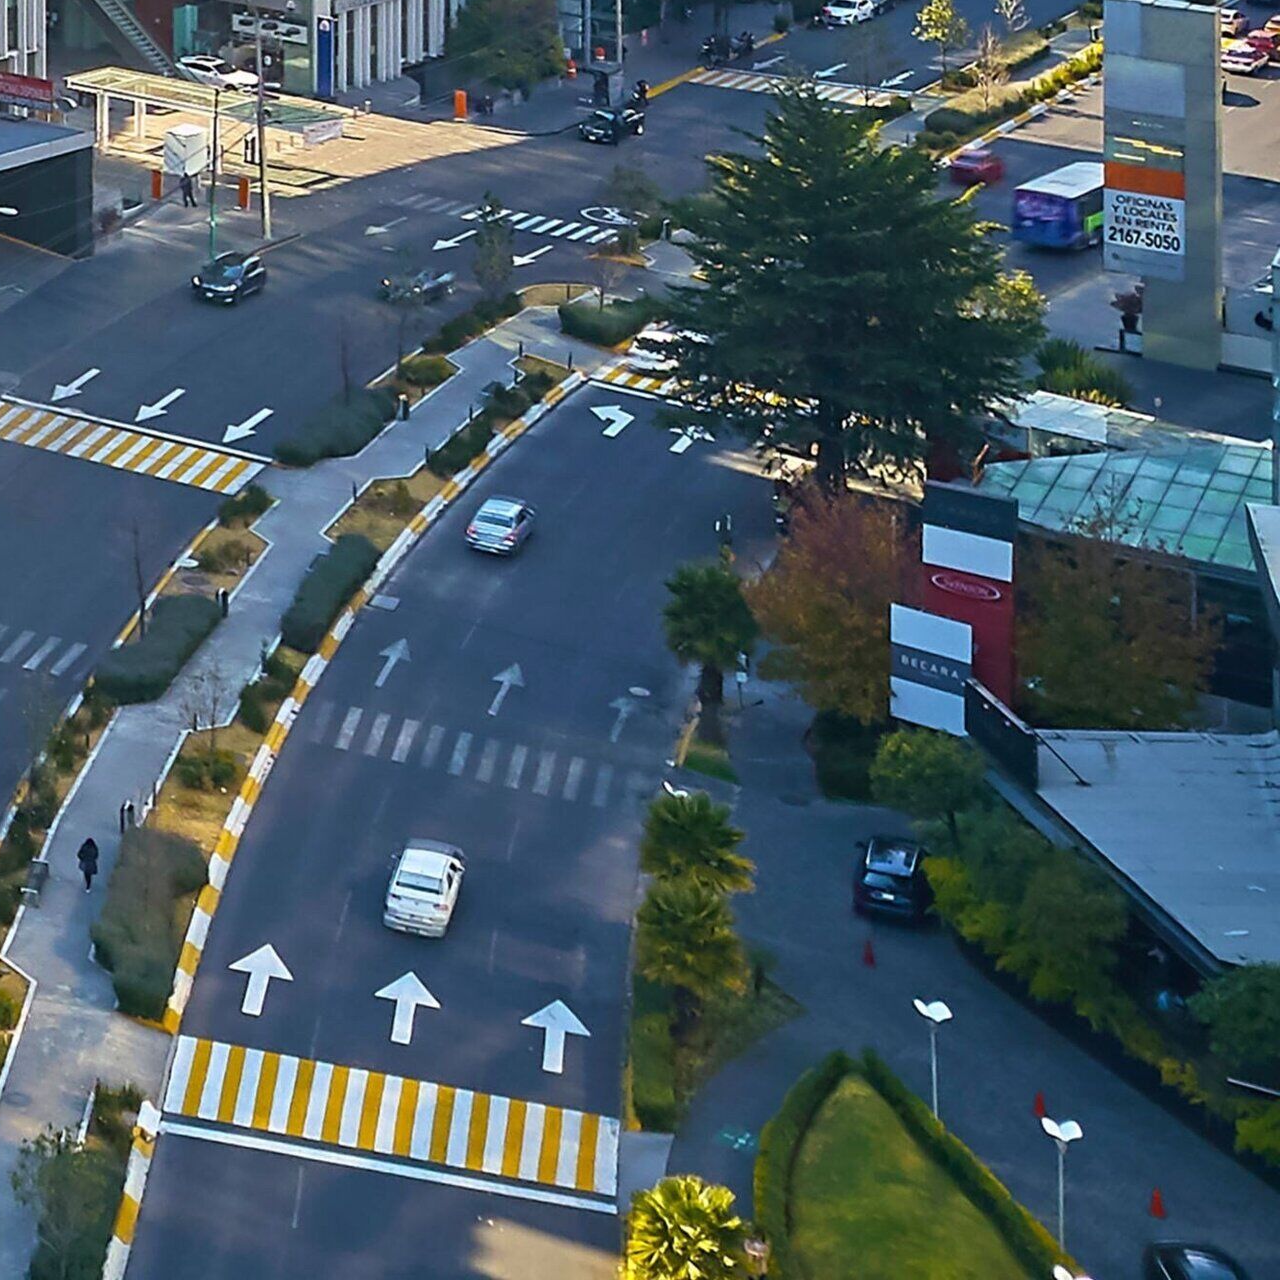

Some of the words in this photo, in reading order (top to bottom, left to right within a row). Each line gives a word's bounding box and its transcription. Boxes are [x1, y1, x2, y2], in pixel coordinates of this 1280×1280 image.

[1116, 194, 1173, 211] OFICINAS
[1111, 204, 1120, 212] Y
[1123, 206, 1178, 222] LOCALES
[1114, 215, 1132, 225] EN
[1135, 219, 1175, 233] RENTA
[1108, 226, 1181, 252] 2167-5050
[901, 654, 959, 679] BECARA
